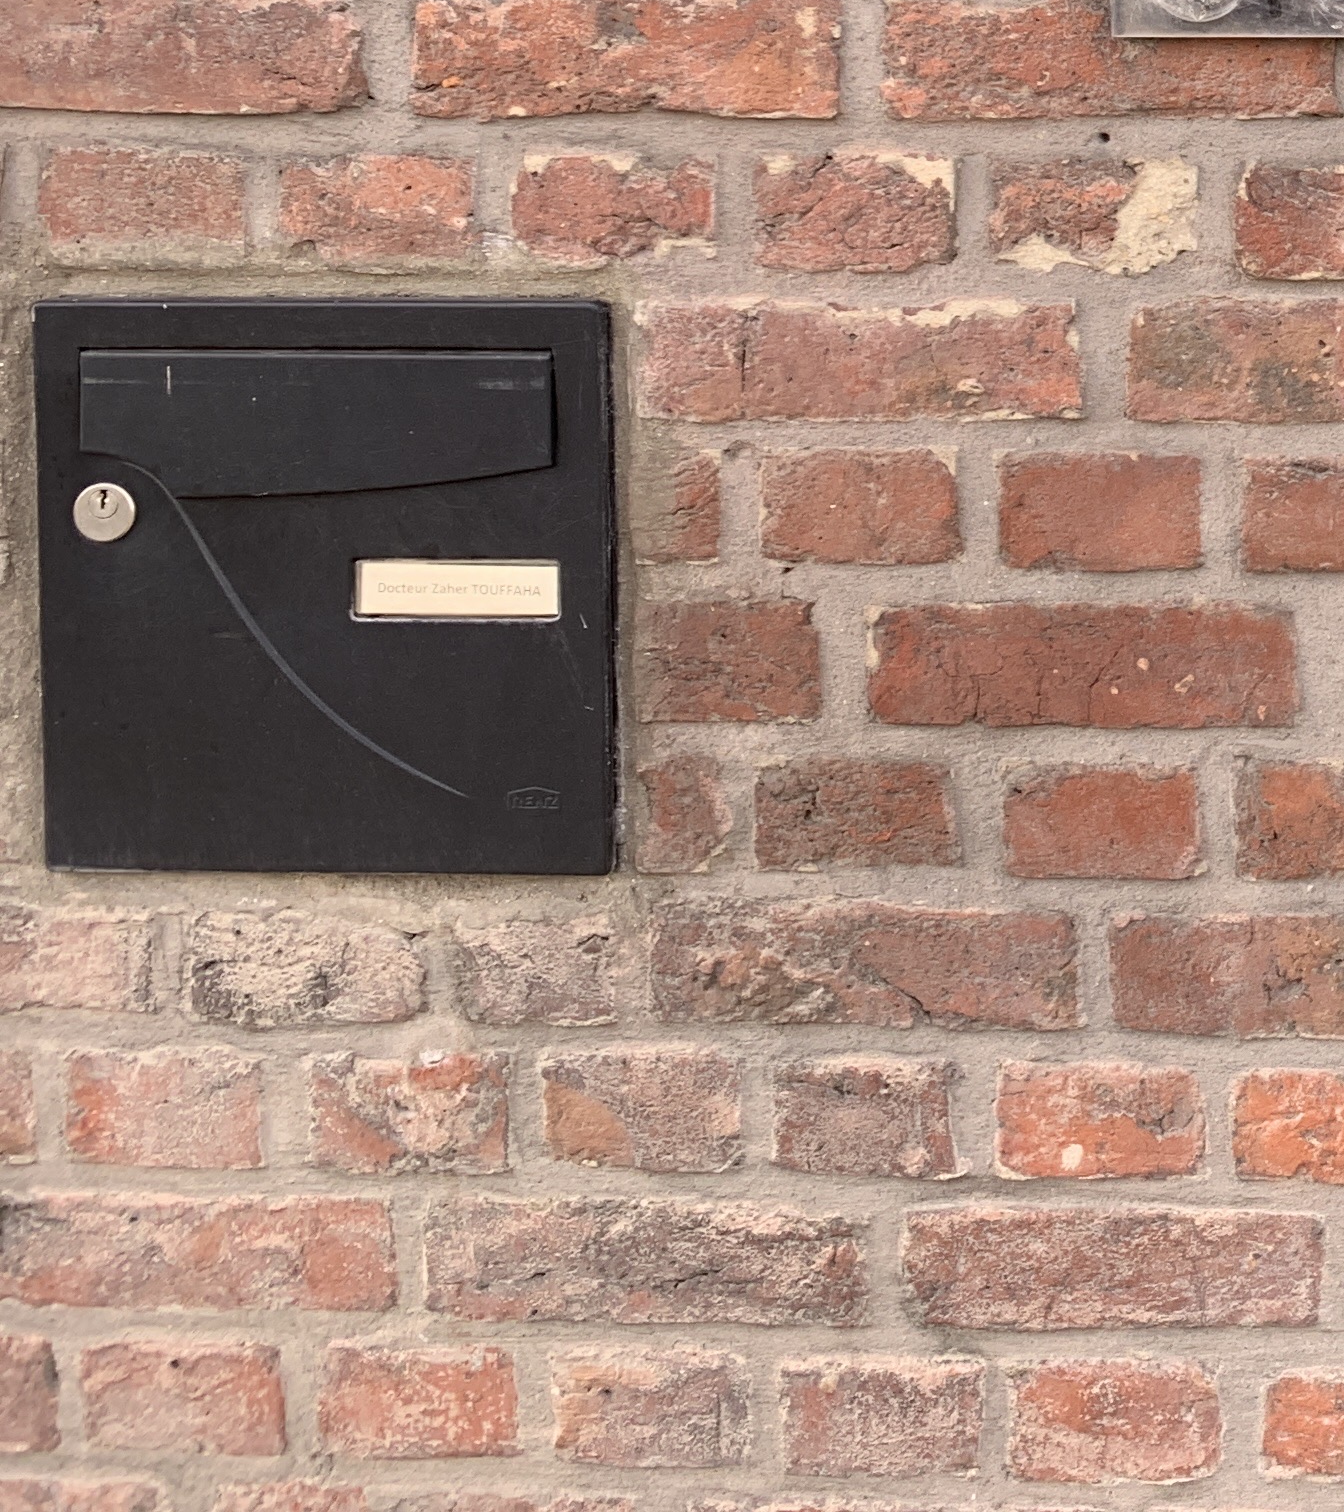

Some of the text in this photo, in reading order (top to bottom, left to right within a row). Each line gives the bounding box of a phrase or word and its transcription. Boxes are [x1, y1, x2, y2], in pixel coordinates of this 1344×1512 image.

[377, 581, 542, 597] Docteur Zaher TOUFFAHA
